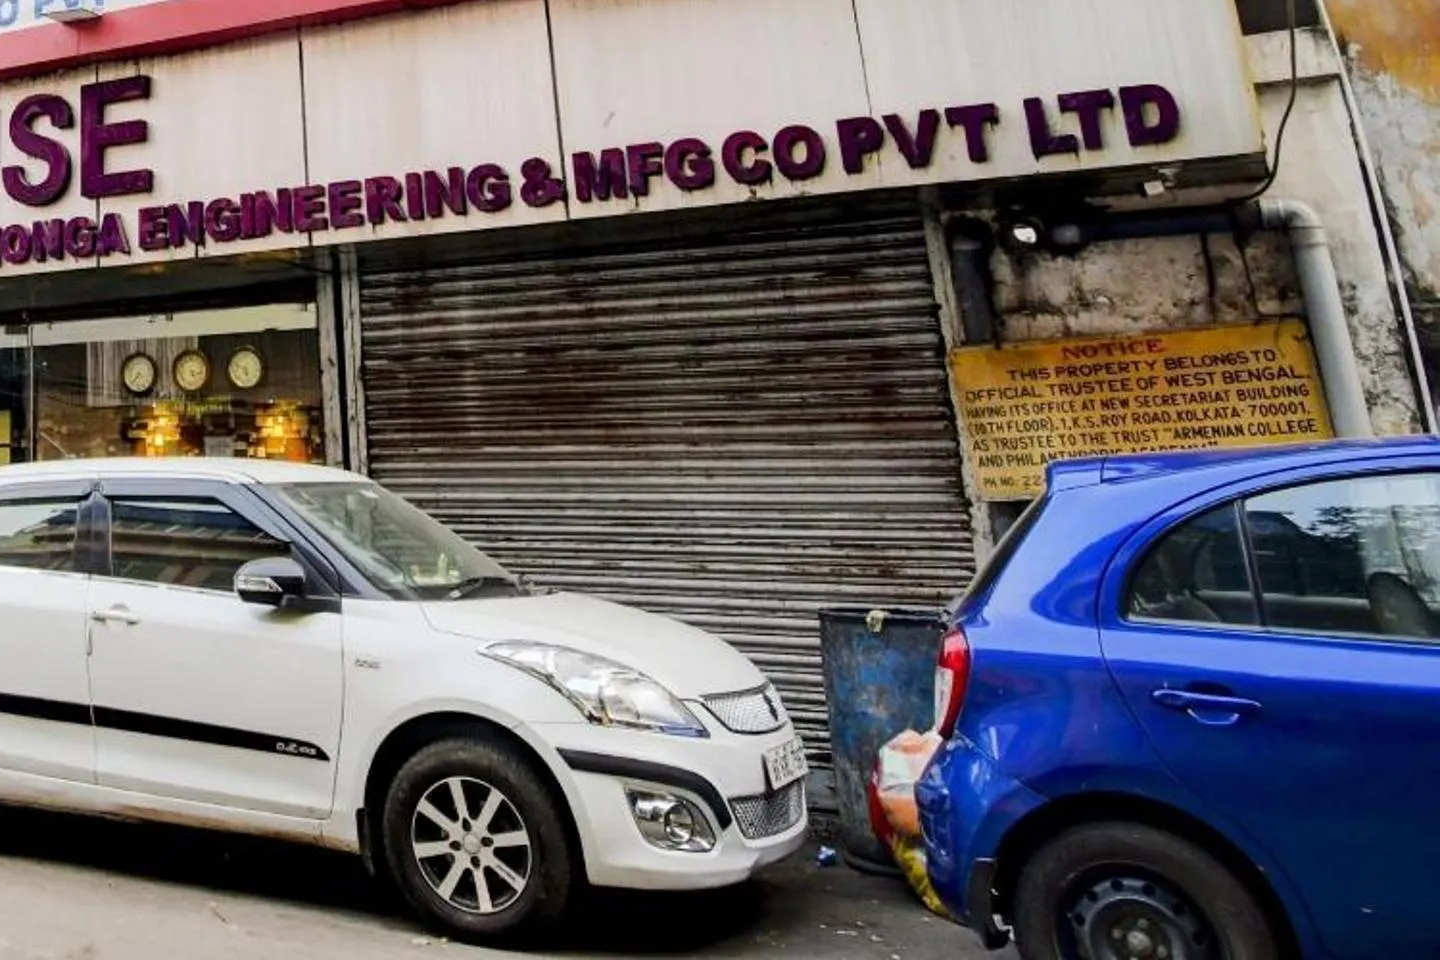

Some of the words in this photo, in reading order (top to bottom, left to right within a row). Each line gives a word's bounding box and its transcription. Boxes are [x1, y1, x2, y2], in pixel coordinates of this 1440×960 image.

[138, 162, 513, 253] ENGINEERING
[520, 156, 564, 209] &
[571, 137, 717, 205] MFG
[722, 124, 826, 189] CO
[835, 102, 1001, 176] PVT
[1022, 83, 1182, 161] LTD
[1007, 367, 1052, 382] THIS
[1056, 360, 1158, 379] PROPERTY
[1165, 351, 1250, 371] BELONGS
[1253, 349, 1277, 364] TO
[1062, 339, 1165, 361] NOTICE
[965, 386, 1043, 403] OFFICIAL
[1047, 379, 1134, 397] TRUSTEE
[1137, 376, 1160, 391] OF
[1165, 371, 1217, 389] WEST
[967, 406, 1007, 420] HAVING
[1011, 403, 1031, 418] ITS
[1033, 400, 1078, 415] OFFICE
[1082, 399, 1097, 413] AT
[1101, 397, 1131, 413] NEW
[1135, 391, 1232, 409] SECRETARIAT
[1237, 384, 1311, 403] BUILDING
[973, 440, 990, 452] AS
[996, 436, 1056, 451] TRUSTEE
[1060, 434, 1078, 447] TO
[1080, 432, 1110, 446] THE
[1113, 429, 1159, 444] TRUST
[1248, 418, 1319, 437] COLLEGE
[979, 454, 1004, 468] AND
